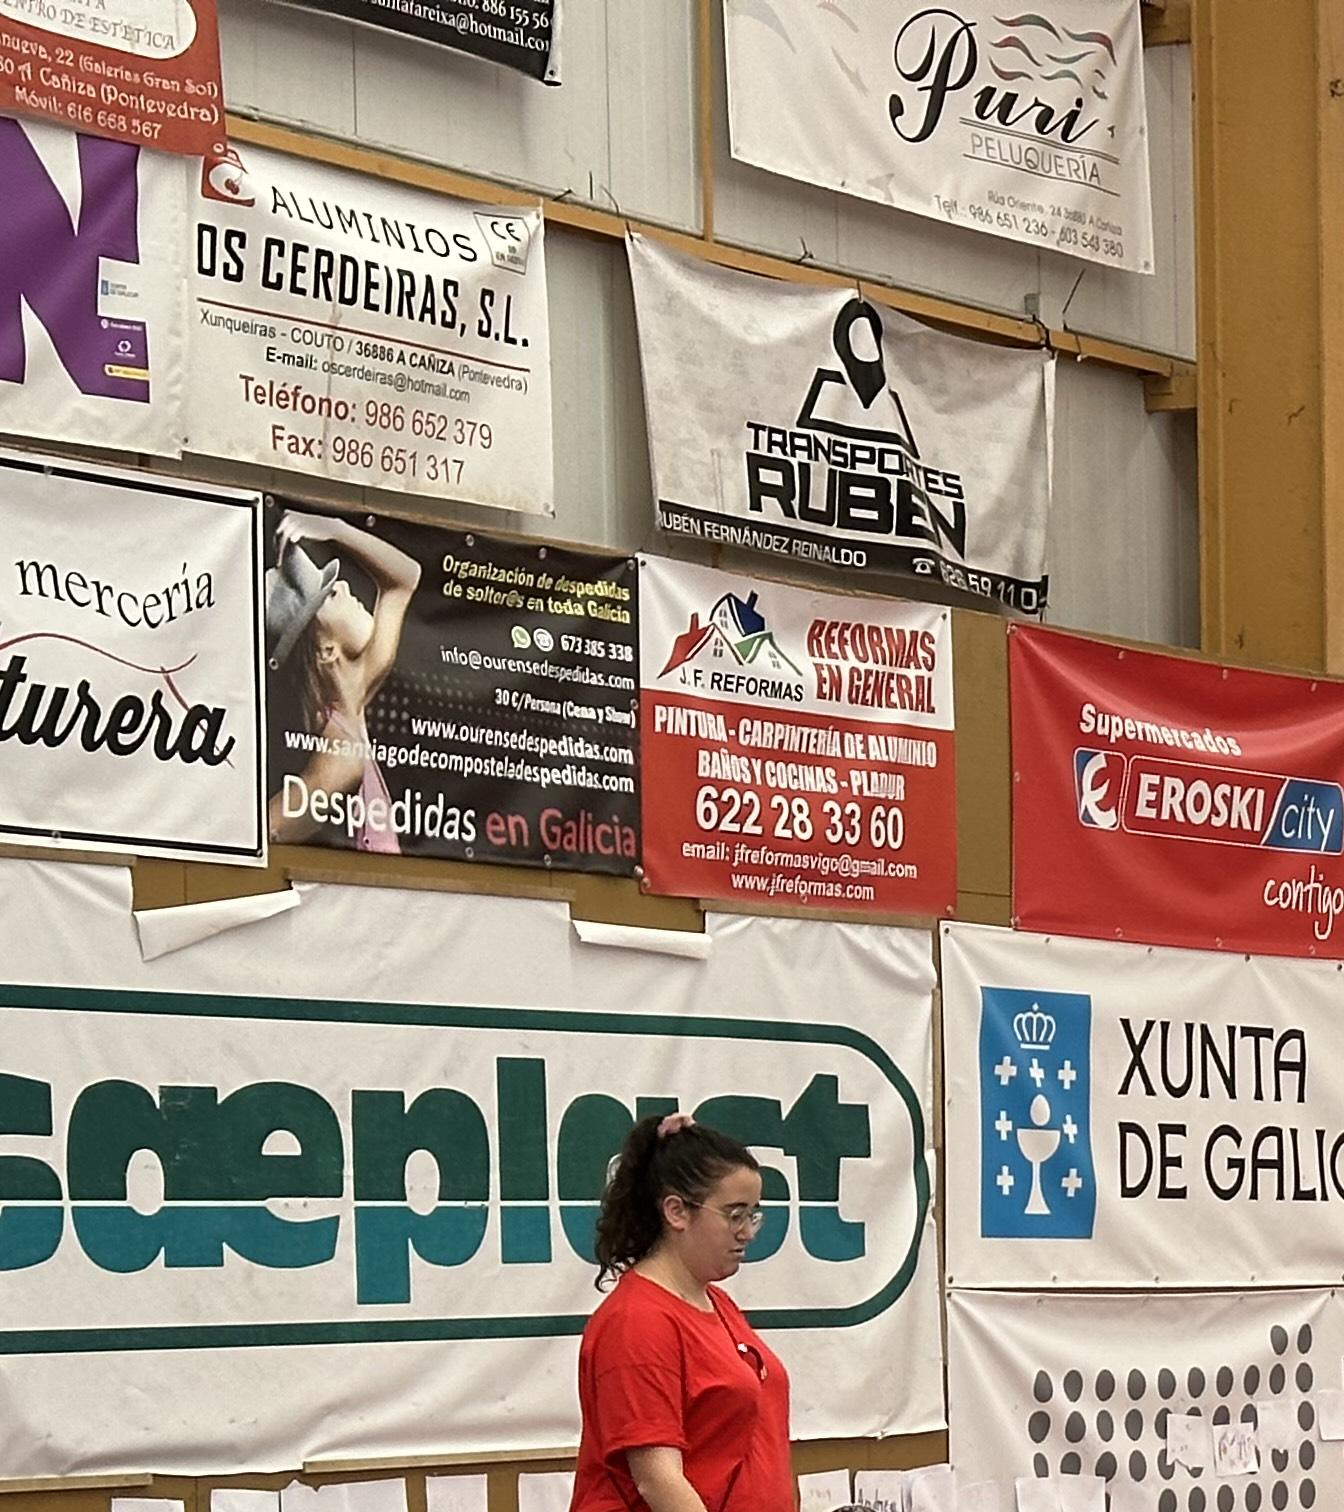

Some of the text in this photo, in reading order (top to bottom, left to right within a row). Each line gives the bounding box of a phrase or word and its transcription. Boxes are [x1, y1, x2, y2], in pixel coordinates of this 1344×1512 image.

[55, 47, 75, 67] 22
[888, 8, 1099, 144] Puri
[15, 85, 163, 139] Móvil: 616 668 567
[40, 67, 220, 125] Cañiza (Pontevedra)
[970, 132, 1101, 184] PELUQUERÍA
[272, 186, 478, 262] ALUMINIOS
[197, 222, 530, 348] OS CERDEIRAS, S.L.
[200, 308, 529, 395] Xunqueiras COUTO CAÑIZA (Pontevedra)
[265, 346, 471, 404] E-mail: oscerdeiras@hotmail.com
[239, 374, 493, 450] Teléfono: 986 652 379
[271, 424, 465, 486] Fax: 986 651 317
[704, 520, 789, 555] FERNÁNDEZ
[792, 538, 867, 569] REINALDO
[15, 558, 216, 630] mercería
[442, 555, 630, 601] Organización de despedidas
[442, 580, 631, 625] de en toda Galicia
[440, 645, 635, 690] info@ourensedespedidas.com
[560, 634, 633, 662] 673 385 338
[806, 619, 936, 673] REFORMAS
[495, 688, 509, 706] 30
[710, 673, 804, 702] REFORMAS
[814, 663, 936, 714] EN GENERAL
[411, 717, 634, 766] www.ourensedespedidas.com
[655, 705, 938, 768] PINTURA CARPINTERÍA DE ALUMINIO
[1079, 703, 1242, 757] Supermercados
[285, 729, 635, 794] www.santiagodecomposteladespedidas.com
[698, 749, 839, 794] BAÑOS COCINAS
[281, 774, 636, 859] Despedidas en Galicia
[696, 785, 904, 850] 622 28 33 60
[1135, 773, 1335, 852] EROSKI city
[682, 842, 918, 879] email: jfreformasvigo@gmail.com
[732, 873, 875, 900] www.jfreformas.com
[1264, 866, 1344, 940] contigo
[1117, 1018, 1307, 1105] XUNTA
[1118, 1122, 1188, 1200] DE
